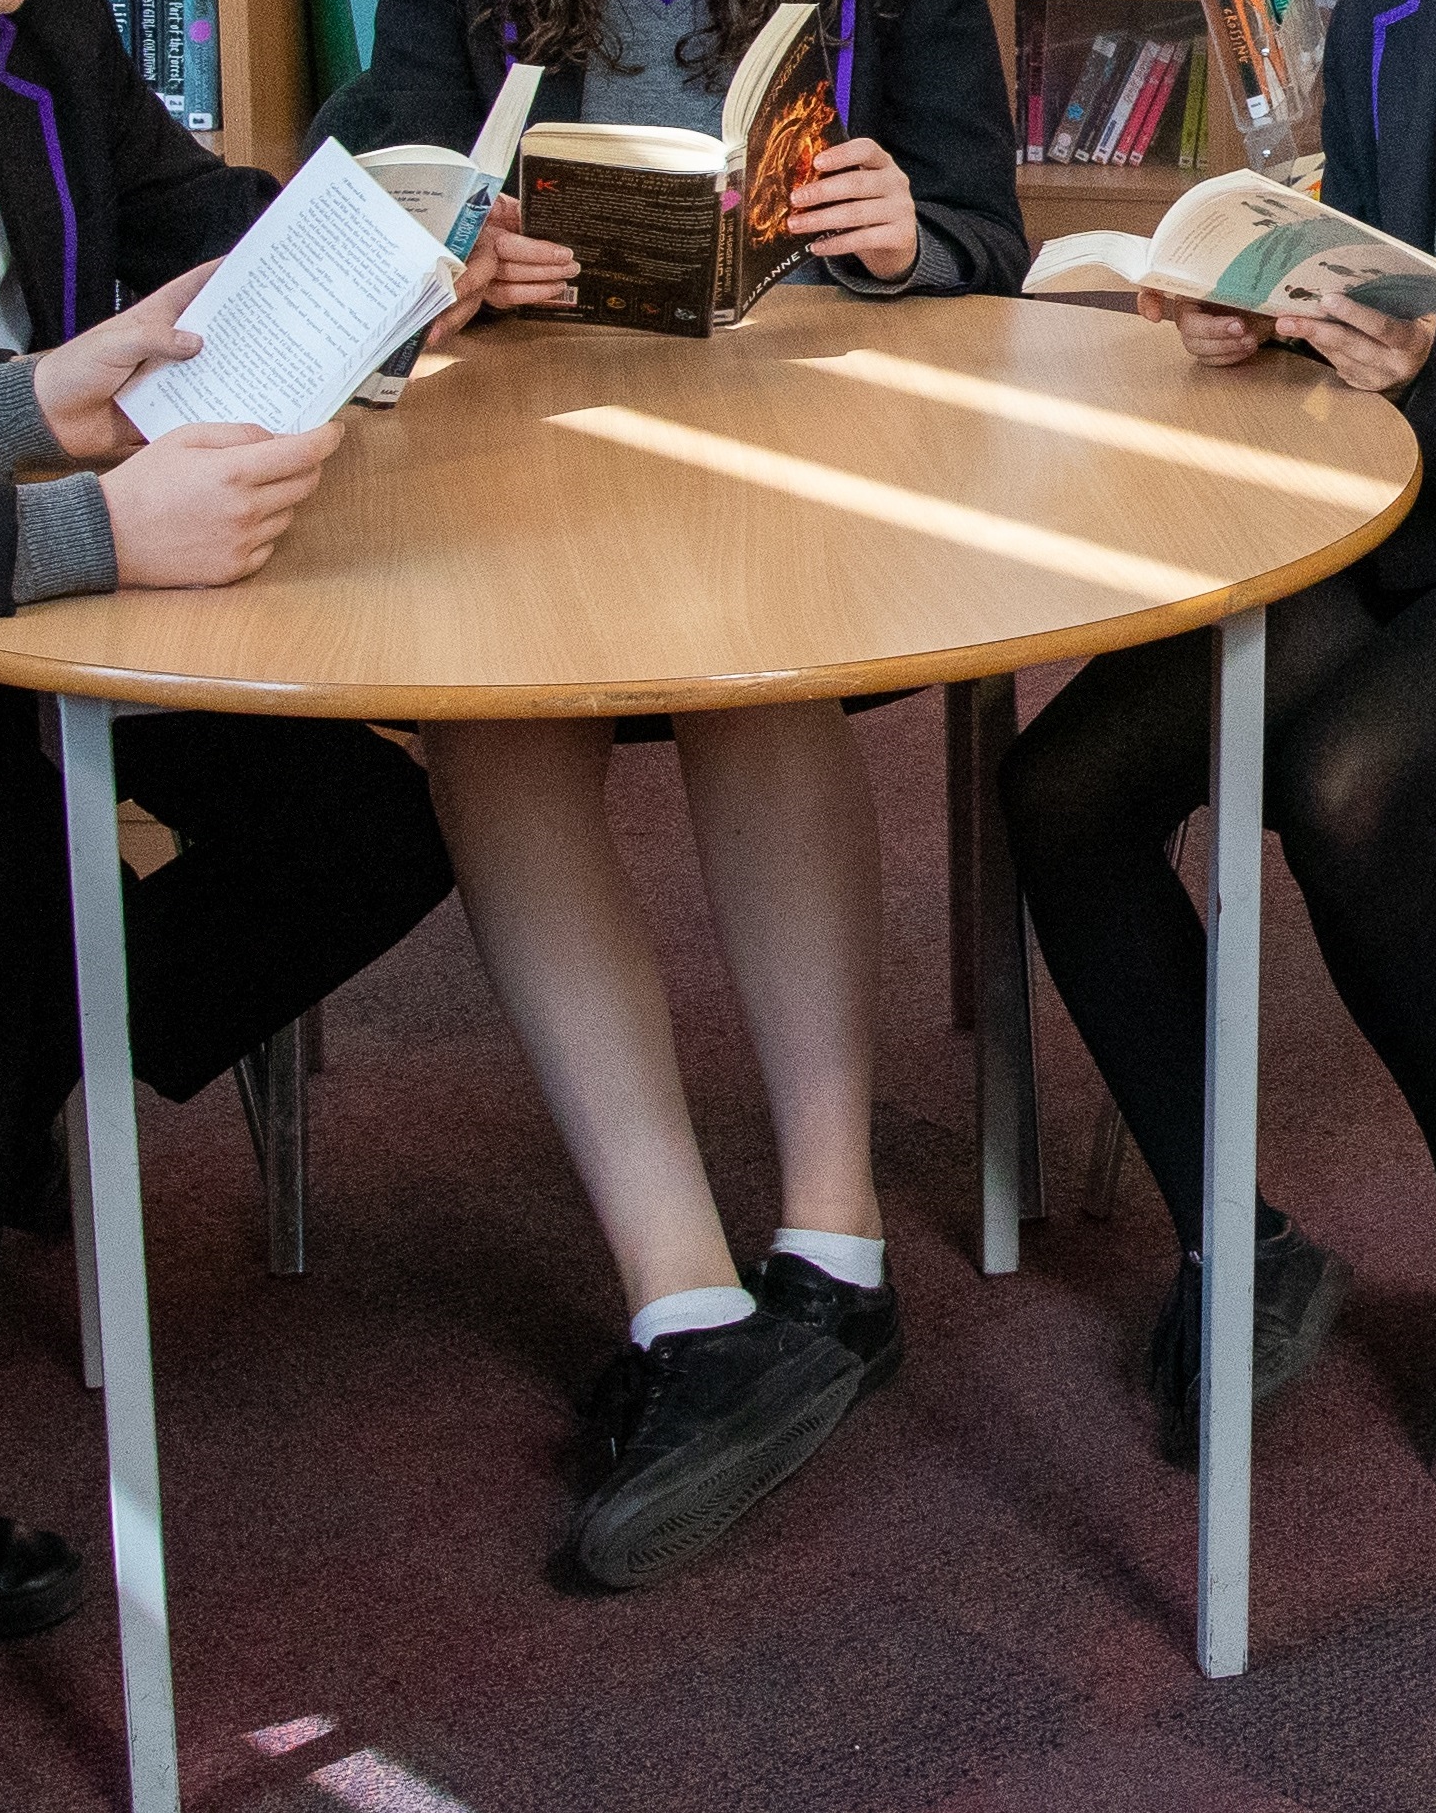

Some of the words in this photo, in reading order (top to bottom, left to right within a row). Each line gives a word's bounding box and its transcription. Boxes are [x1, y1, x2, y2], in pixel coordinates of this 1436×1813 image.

[143, 8, 156, 31] GIRL
[169, 2, 184, 23] Part
[169, 24, 184, 36] of
[1224, 8, 1251, 63] CROSSING
[169, 37, 184, 53] the
[142, 38, 156, 81] COLDTOWN
[168, 54, 184, 83] Forest
[740, 250, 801, 312] SUZANNE
